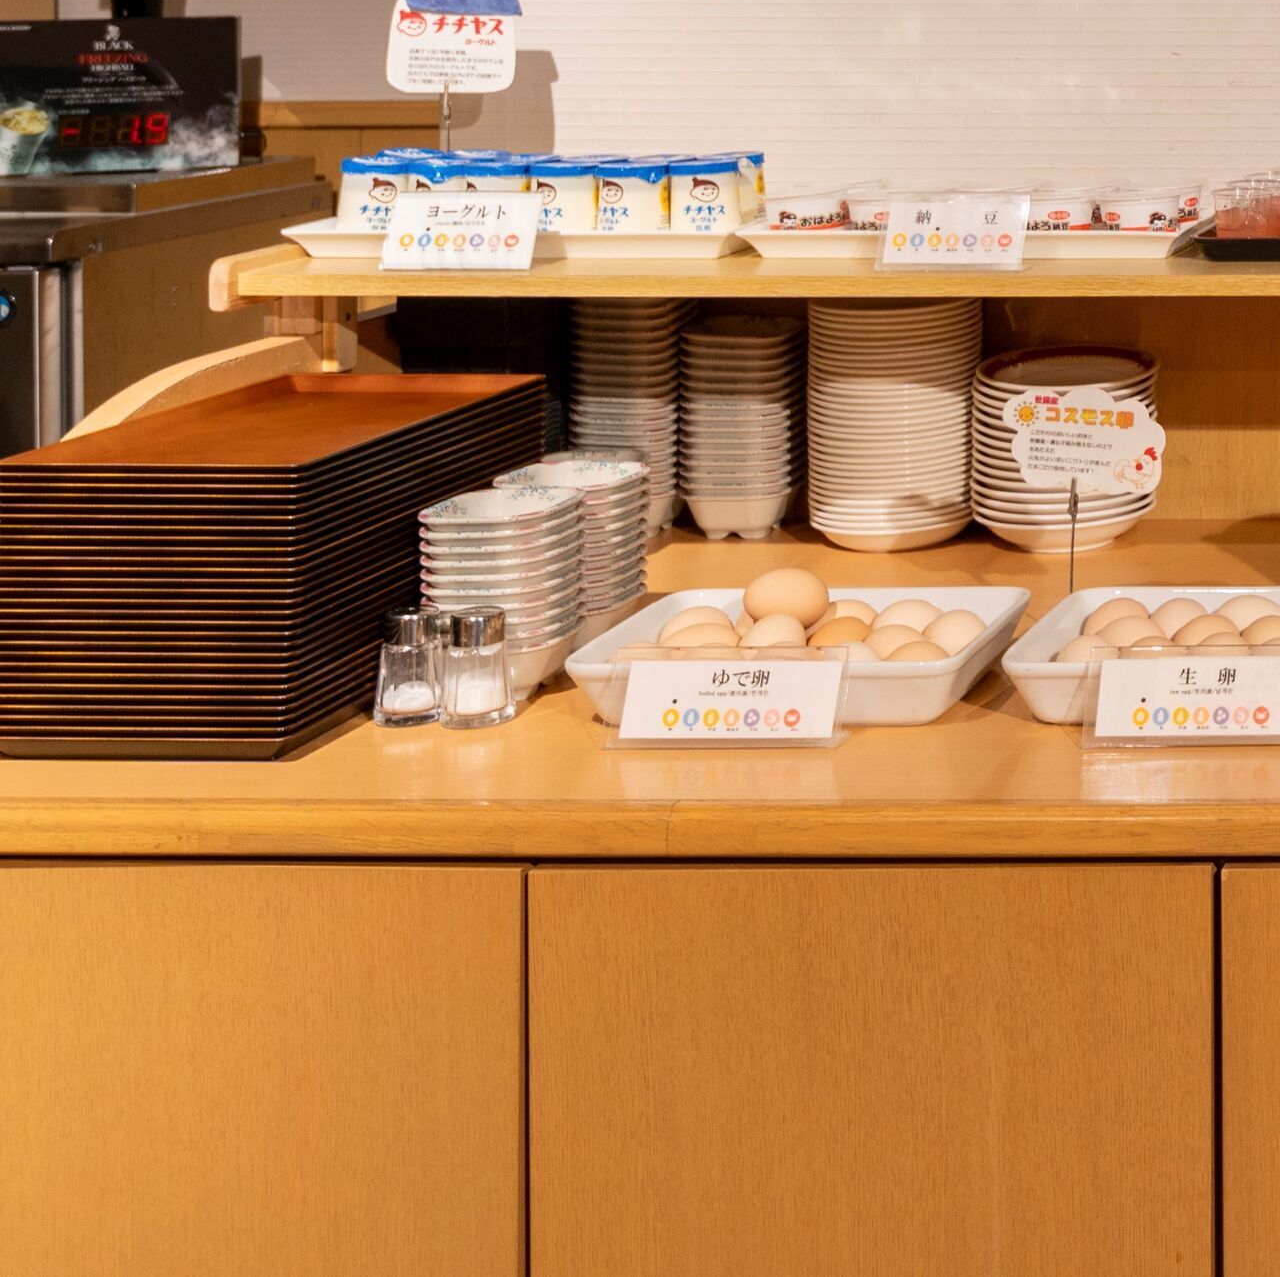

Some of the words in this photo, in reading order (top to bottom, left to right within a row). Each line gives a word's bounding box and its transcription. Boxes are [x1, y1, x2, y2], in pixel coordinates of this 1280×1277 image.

[433, 14, 504, 35] チチヤス
[427, 204, 507, 220] ヨーグルト
[683, 205, 726, 215] チチヤス
[1045, 406, 1135, 429] コスモス卵
[712, 668, 770, 688] ゆで卵
